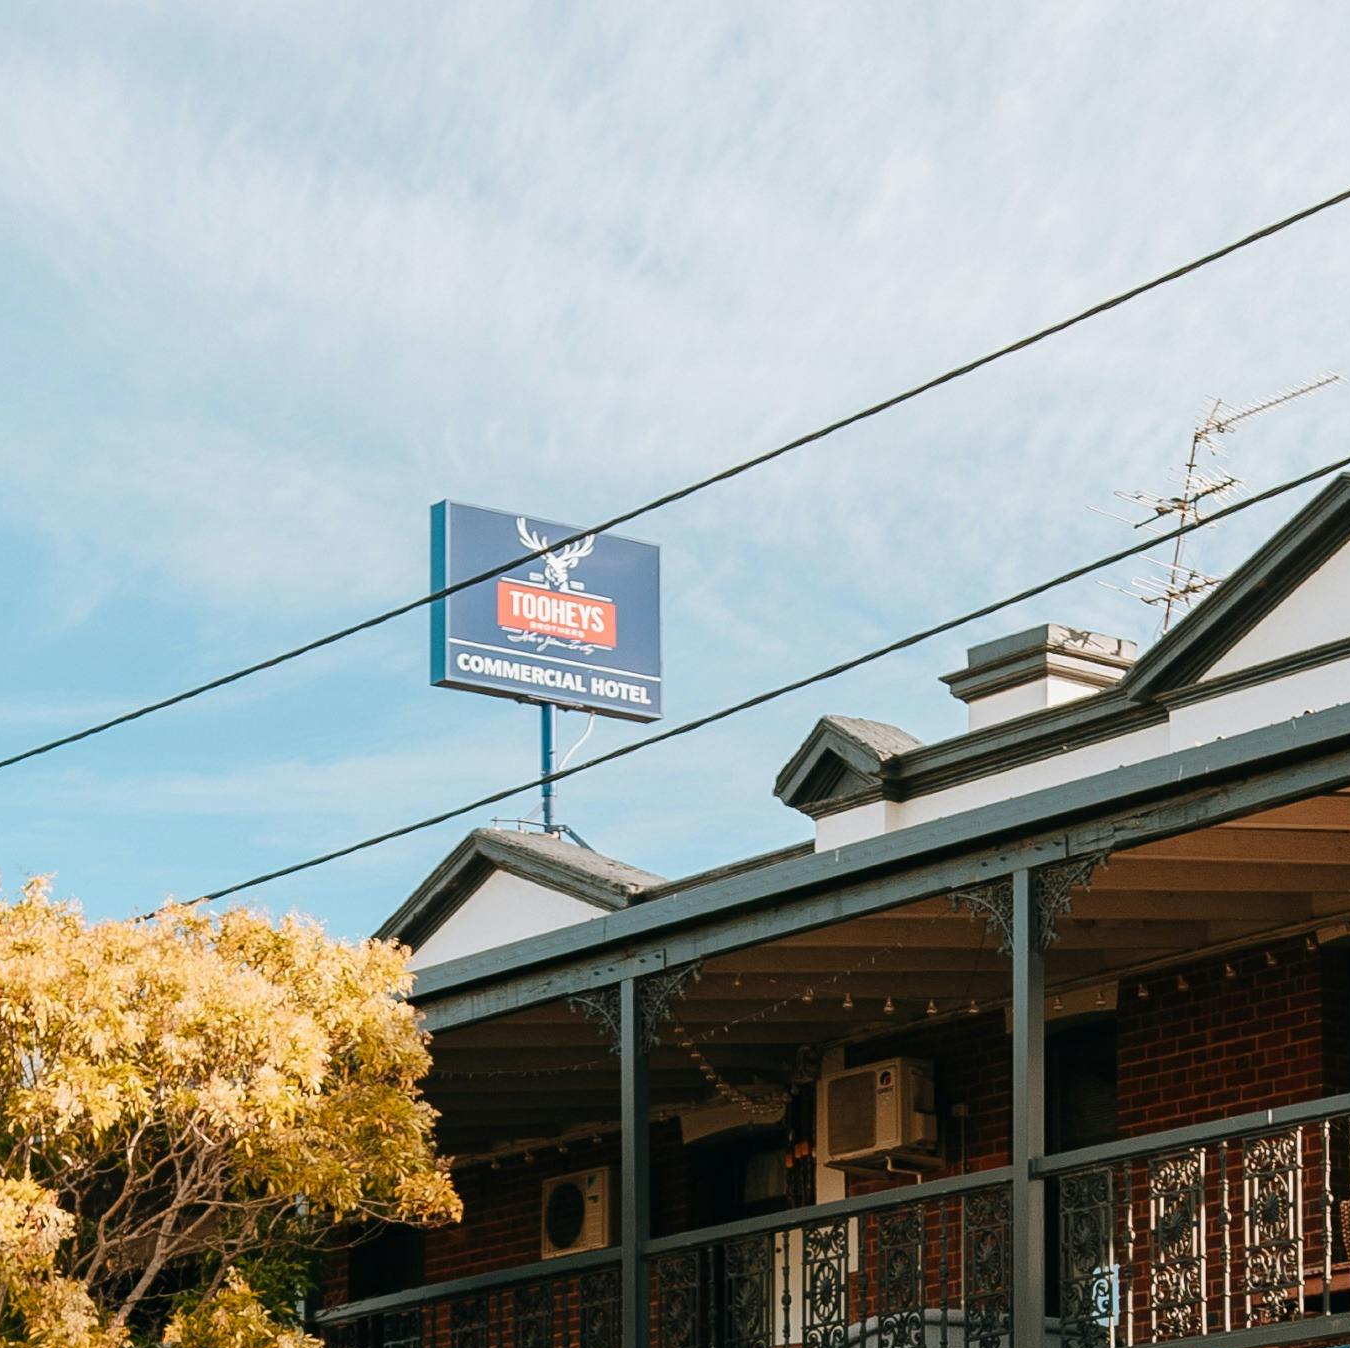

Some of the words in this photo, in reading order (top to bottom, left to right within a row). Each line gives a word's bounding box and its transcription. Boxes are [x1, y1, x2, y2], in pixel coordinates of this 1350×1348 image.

[509, 590, 605, 633] TOOHEYS
[456, 653, 587, 693] COMMERCIAL
[591, 677, 652, 705] HOTEL
